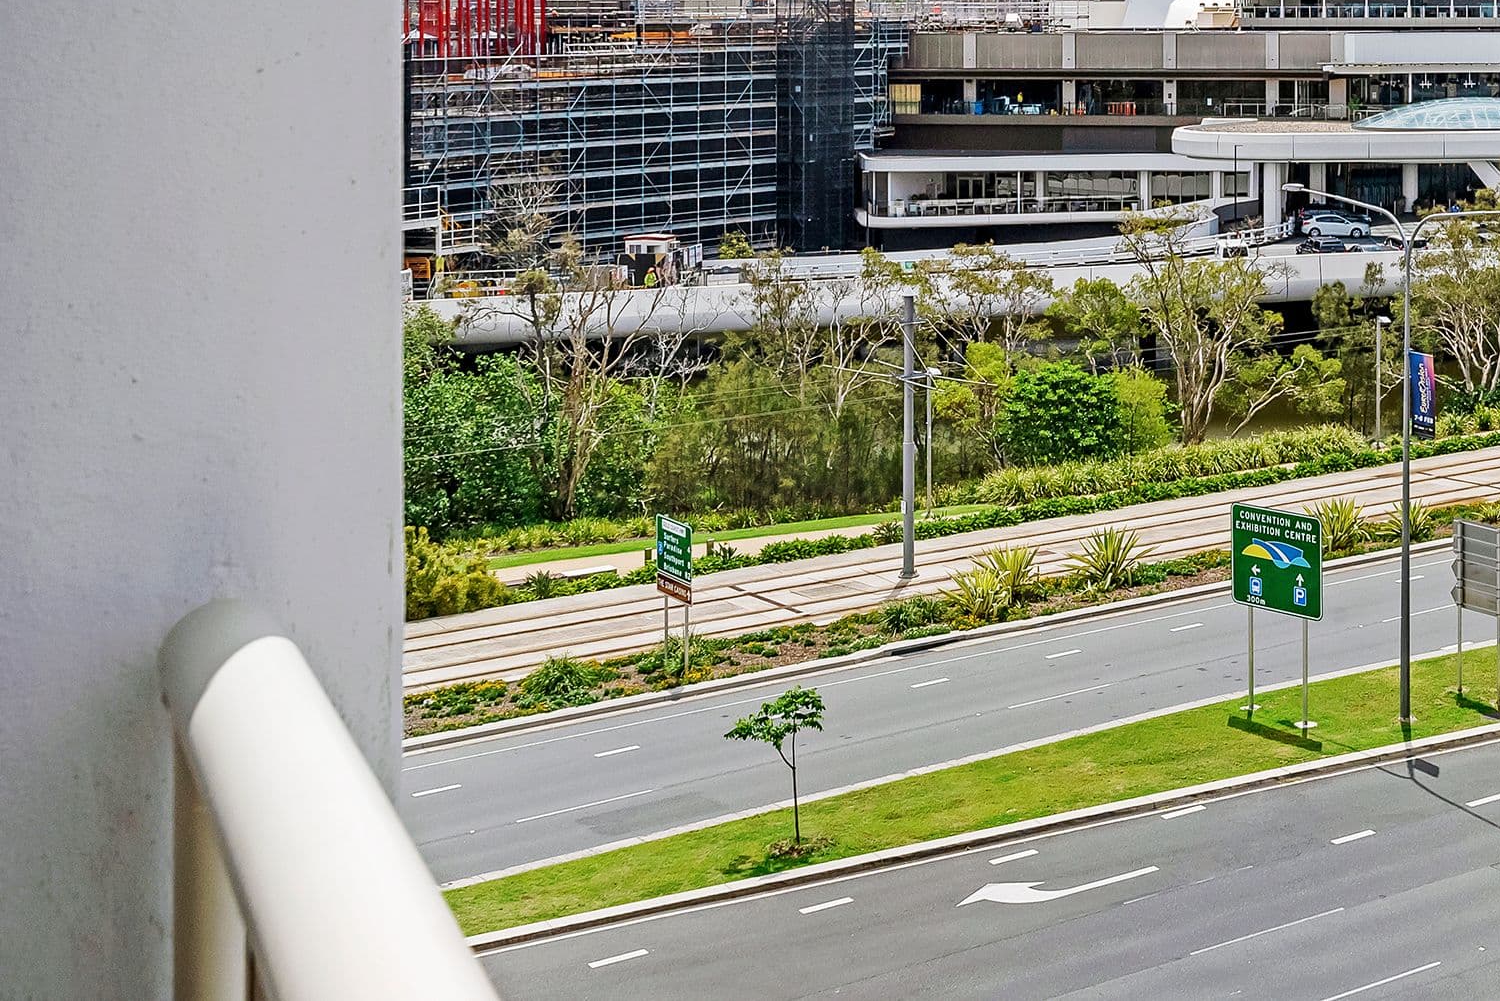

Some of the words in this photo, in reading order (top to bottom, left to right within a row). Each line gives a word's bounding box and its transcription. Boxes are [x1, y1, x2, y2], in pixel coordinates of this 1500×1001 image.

[1235, 520, 1281, 537] EXHIBITION
[1284, 530, 1317, 544] CENTRE
[1239, 510, 1291, 528] CONVENTION
[1294, 521, 1313, 532] AND
[1246, 595, 1266, 605] 300m
